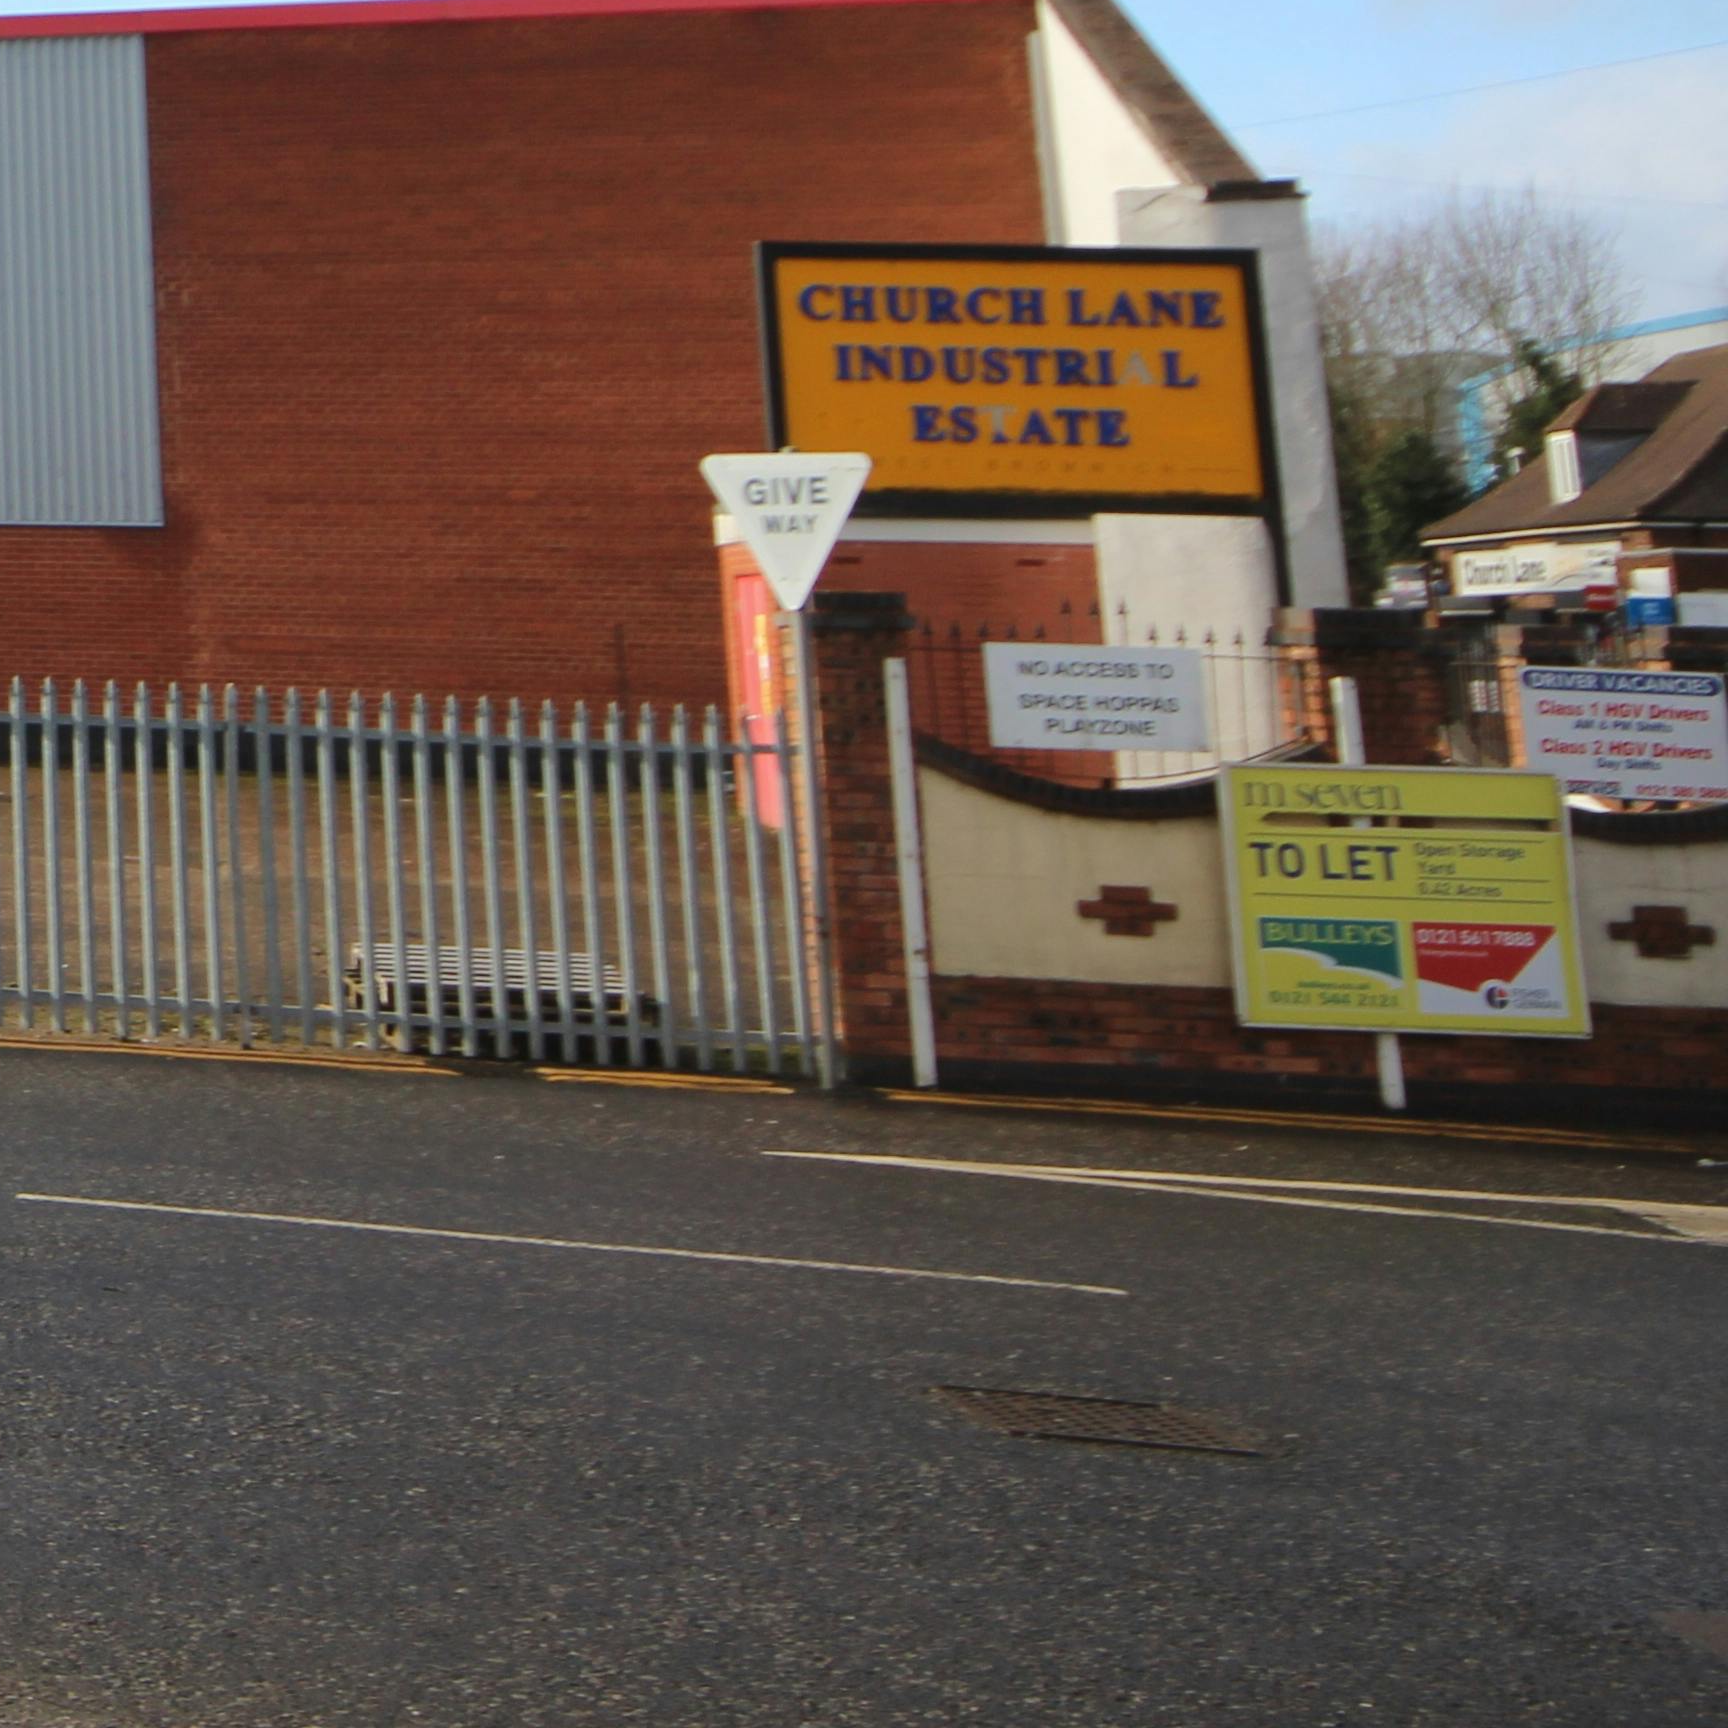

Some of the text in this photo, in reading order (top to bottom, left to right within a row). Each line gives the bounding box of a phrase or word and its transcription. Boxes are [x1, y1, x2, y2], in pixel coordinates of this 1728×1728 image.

[798, 282, 1226, 329] CHURCH LANE
[834, 343, 1200, 389] INDUSTRIAL
[910, 403, 1132, 447] ESTATE
[744, 476, 830, 506] GIVE
[763, 515, 818, 534] WAY
[1017, 659, 1175, 680] NO ACCESS TO
[1530, 672, 1713, 695] DRIVER VACANCIES
[1018, 692, 1180, 713] SPACE HOPPAS
[1536, 699, 1711, 722] Class 1 HGV Drivers
[1044, 717, 1157, 736] PLAYZONE
[1540, 738, 1713, 760] Class 2 HGV Drivers
[1294, 781, 1403, 811] seven
[1248, 841, 1400, 882] TO LET
[1414, 841, 1526, 861] Open Storage
[1417, 860, 1456, 875] Yard
[1264, 921, 1394, 946] BULLEYS
